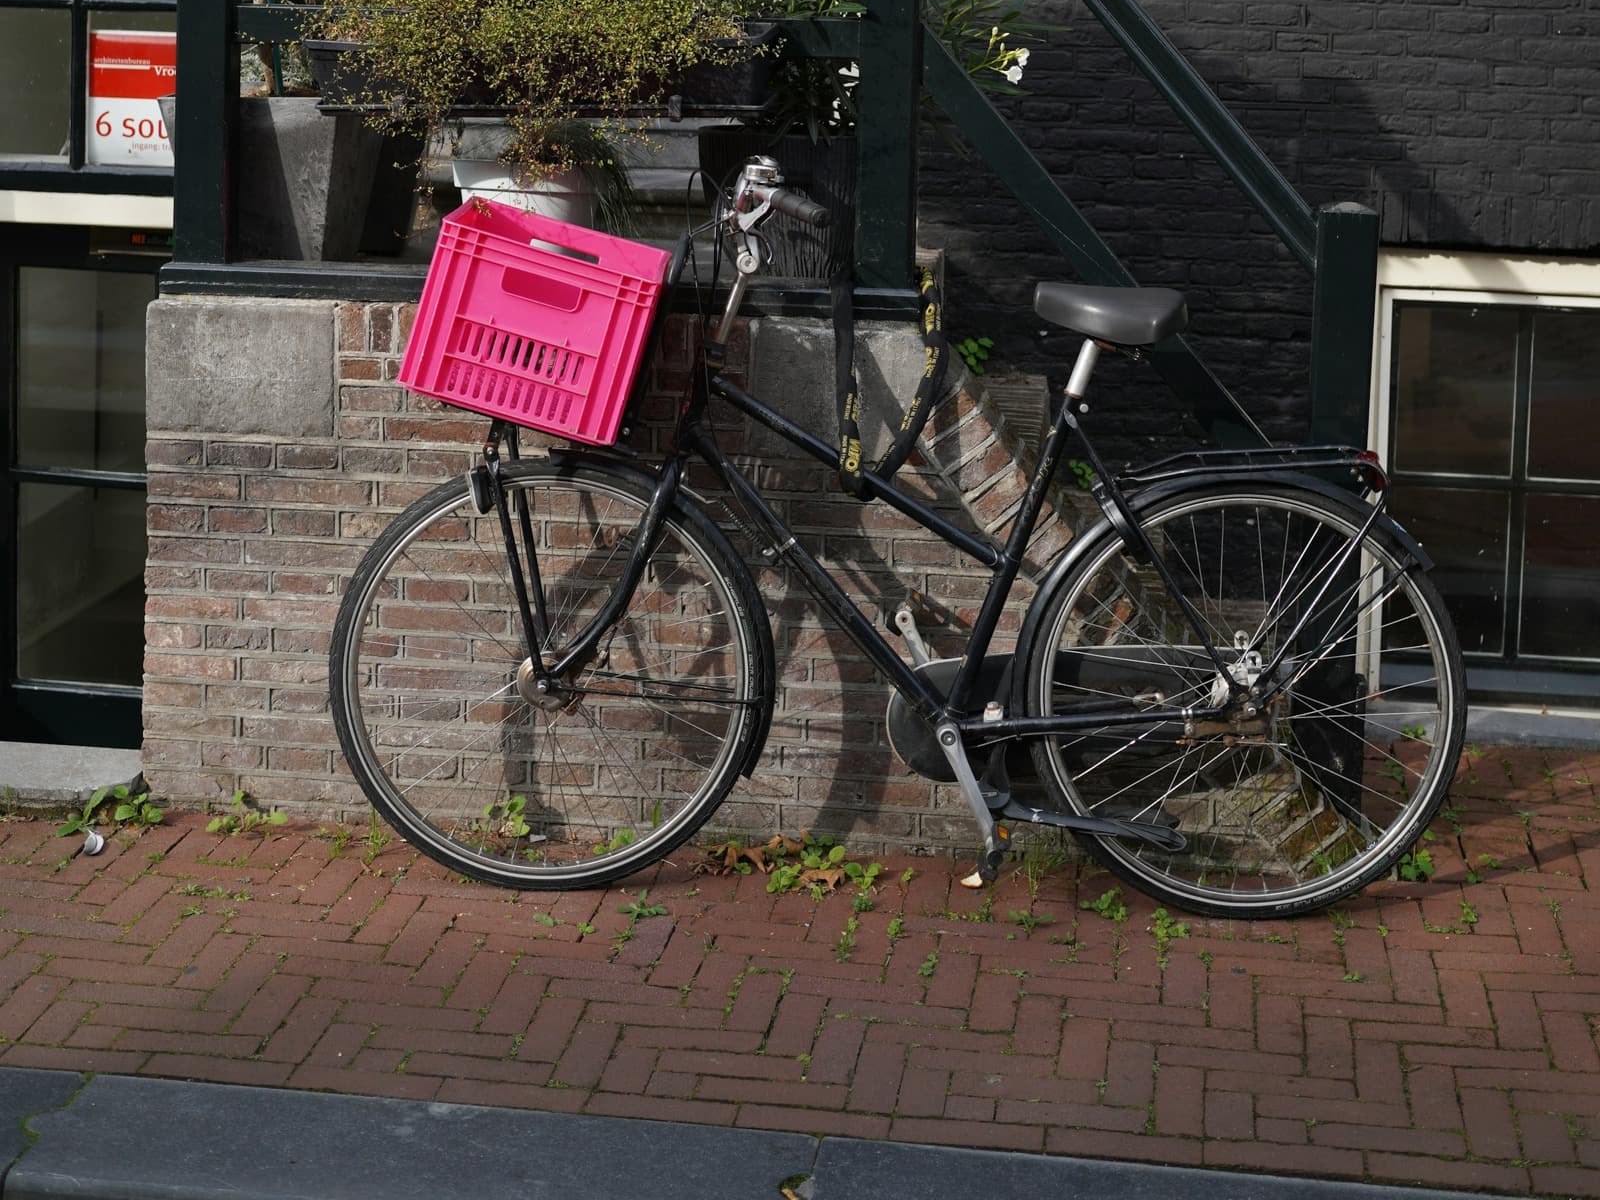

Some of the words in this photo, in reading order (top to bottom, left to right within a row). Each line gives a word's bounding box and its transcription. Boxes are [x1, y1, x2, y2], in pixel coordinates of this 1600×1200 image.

[94, 56, 150, 65] architectenbureau
[154, 65, 176, 76] Vro
[96, 111, 112, 137] 6
[132, 143, 160, 152] ingang:
